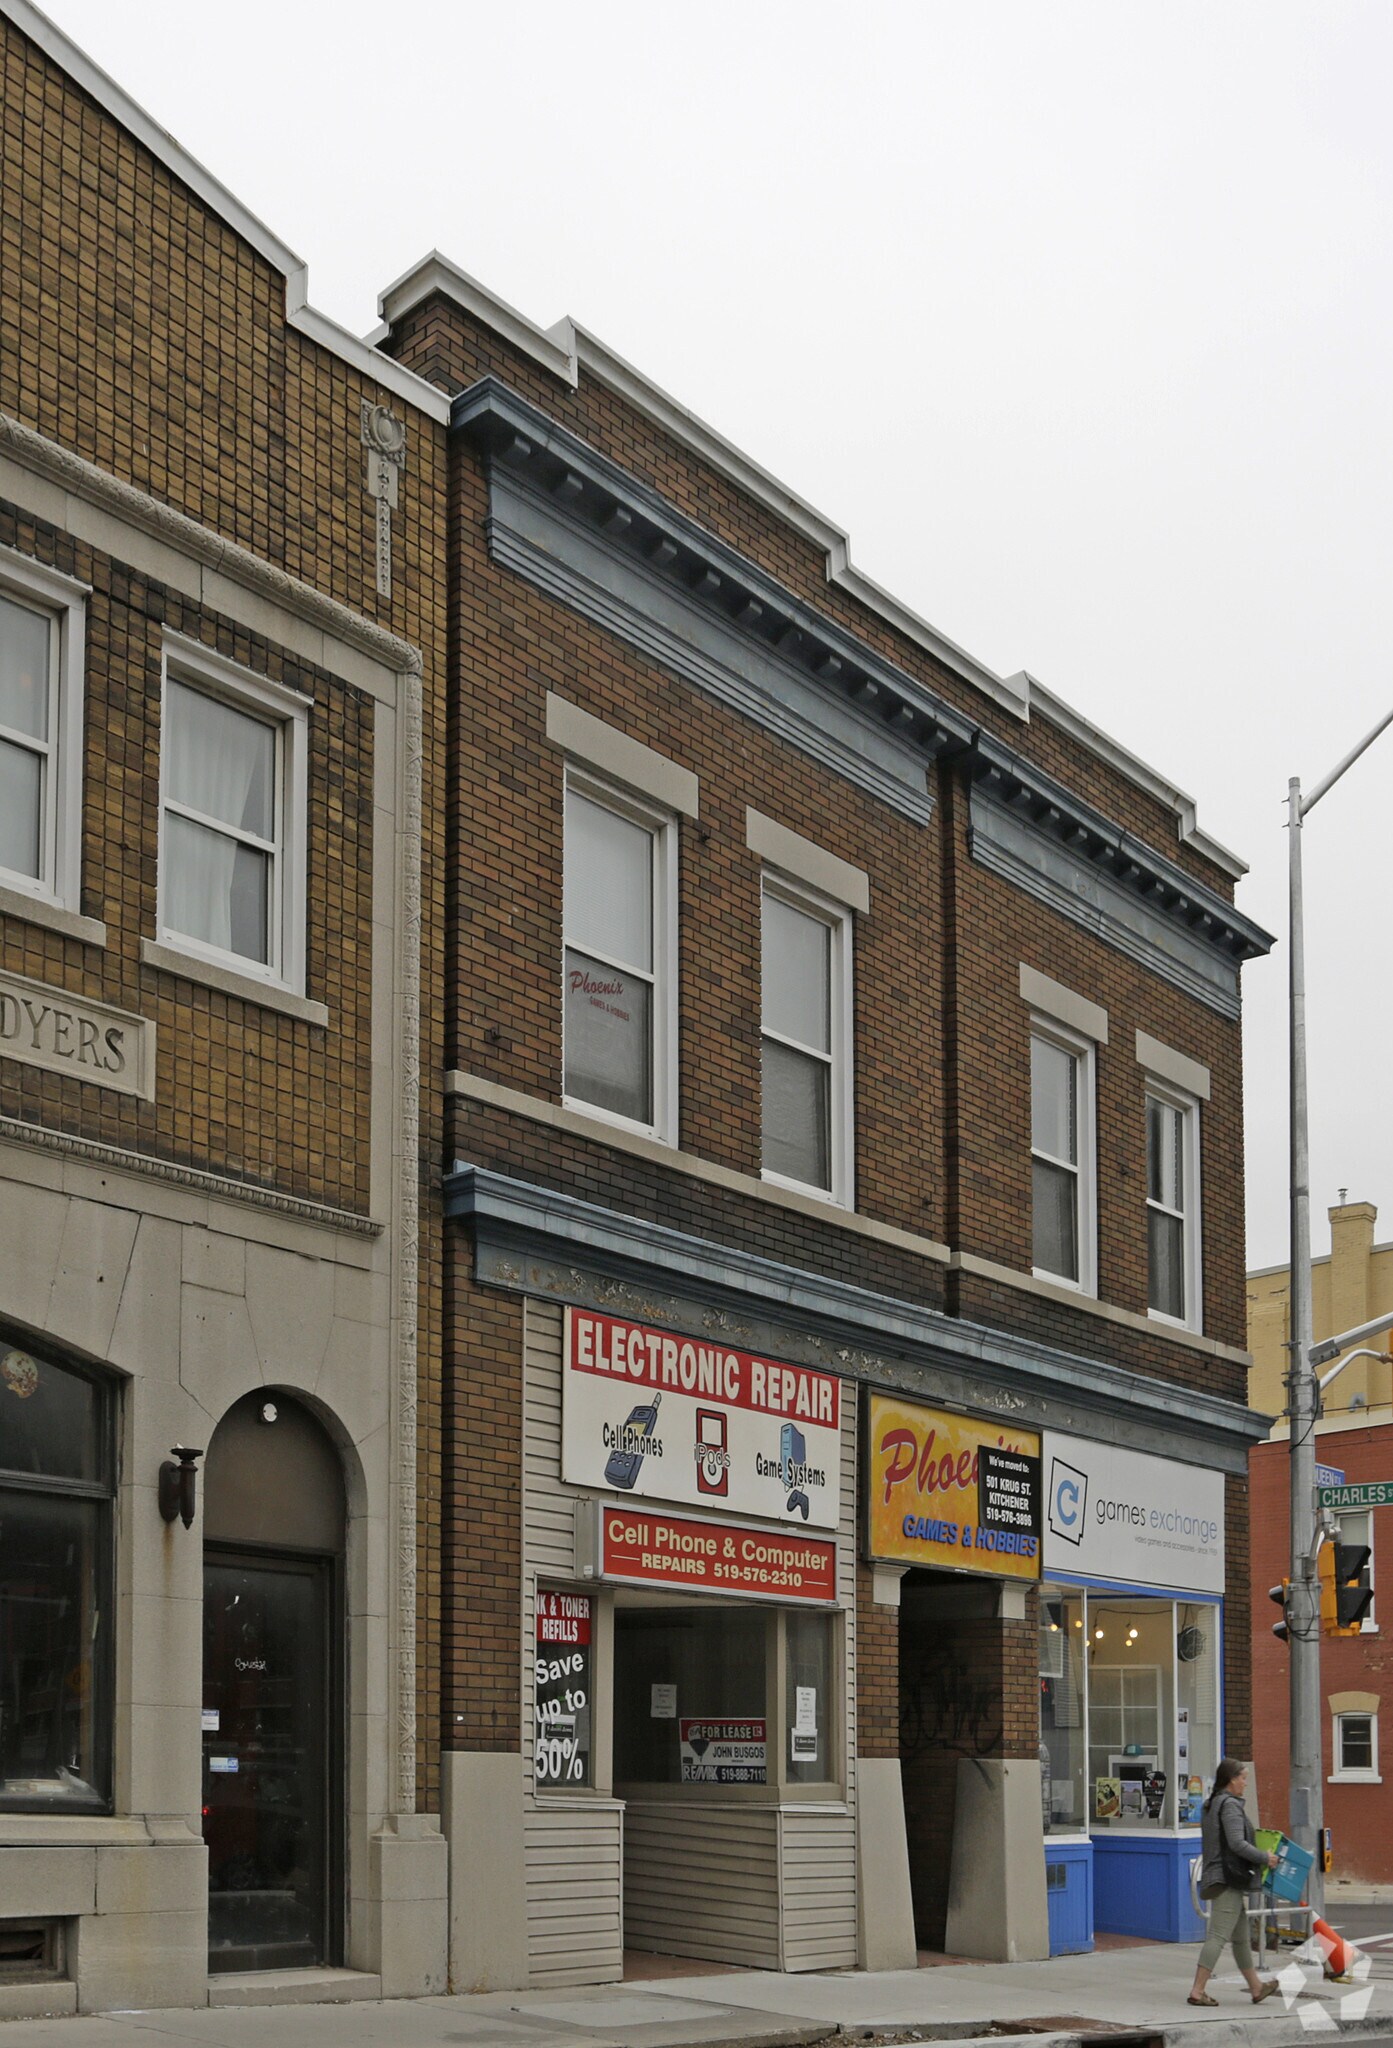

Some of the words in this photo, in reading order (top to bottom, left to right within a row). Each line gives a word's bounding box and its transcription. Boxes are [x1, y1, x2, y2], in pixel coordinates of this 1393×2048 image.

[569, 971, 624, 994] Phoenix
[0, 991, 126, 1074] DYERS
[577, 1317, 740, 1400] ELECTRONIC
[751, 1361, 833, 1422] REPAIR
[694, 1443, 731, 1468] iPods
[1005, 1461, 1023, 1472] moved
[756, 1452, 783, 1480] Game
[787, 1457, 826, 1488] Systems
[986, 1475, 998, 1489] 501
[1000, 1478, 1020, 1494] KRUG
[1020, 1482, 1032, 1496] ST.
[1322, 1485, 1386, 1506] CHARLES
[989, 1491, 1030, 1511] KITCHENER
[1096, 1499, 1146, 1526] games
[1150, 1509, 1217, 1543] exchange
[608, 1519, 649, 1546] Cell
[655, 1526, 717, 1555] Phone
[722, 1537, 736, 1559] &
[741, 1540, 828, 1571] Computer
[903, 1514, 958, 1545] GAMES
[962, 1525, 973, 1547] &
[975, 1527, 1039, 1557] HOBBIES
[641, 1552, 706, 1575] REPAIRS
[713, 1563, 802, 1587] 519-576-2310
[550, 1595, 557, 1617] &
[560, 1596, 590, 1619] TONER
[542, 1618, 578, 1642] REFILLS
[535, 1653, 584, 1684] Save
[535, 1698, 561, 1725] up
[565, 1688, 586, 1712] to
[701, 1725, 720, 1738] FOR
[722, 1725, 752, 1739] LEASE
[535, 1738, 583, 1779] 50%
[712, 1746, 733, 1758] JOHN
